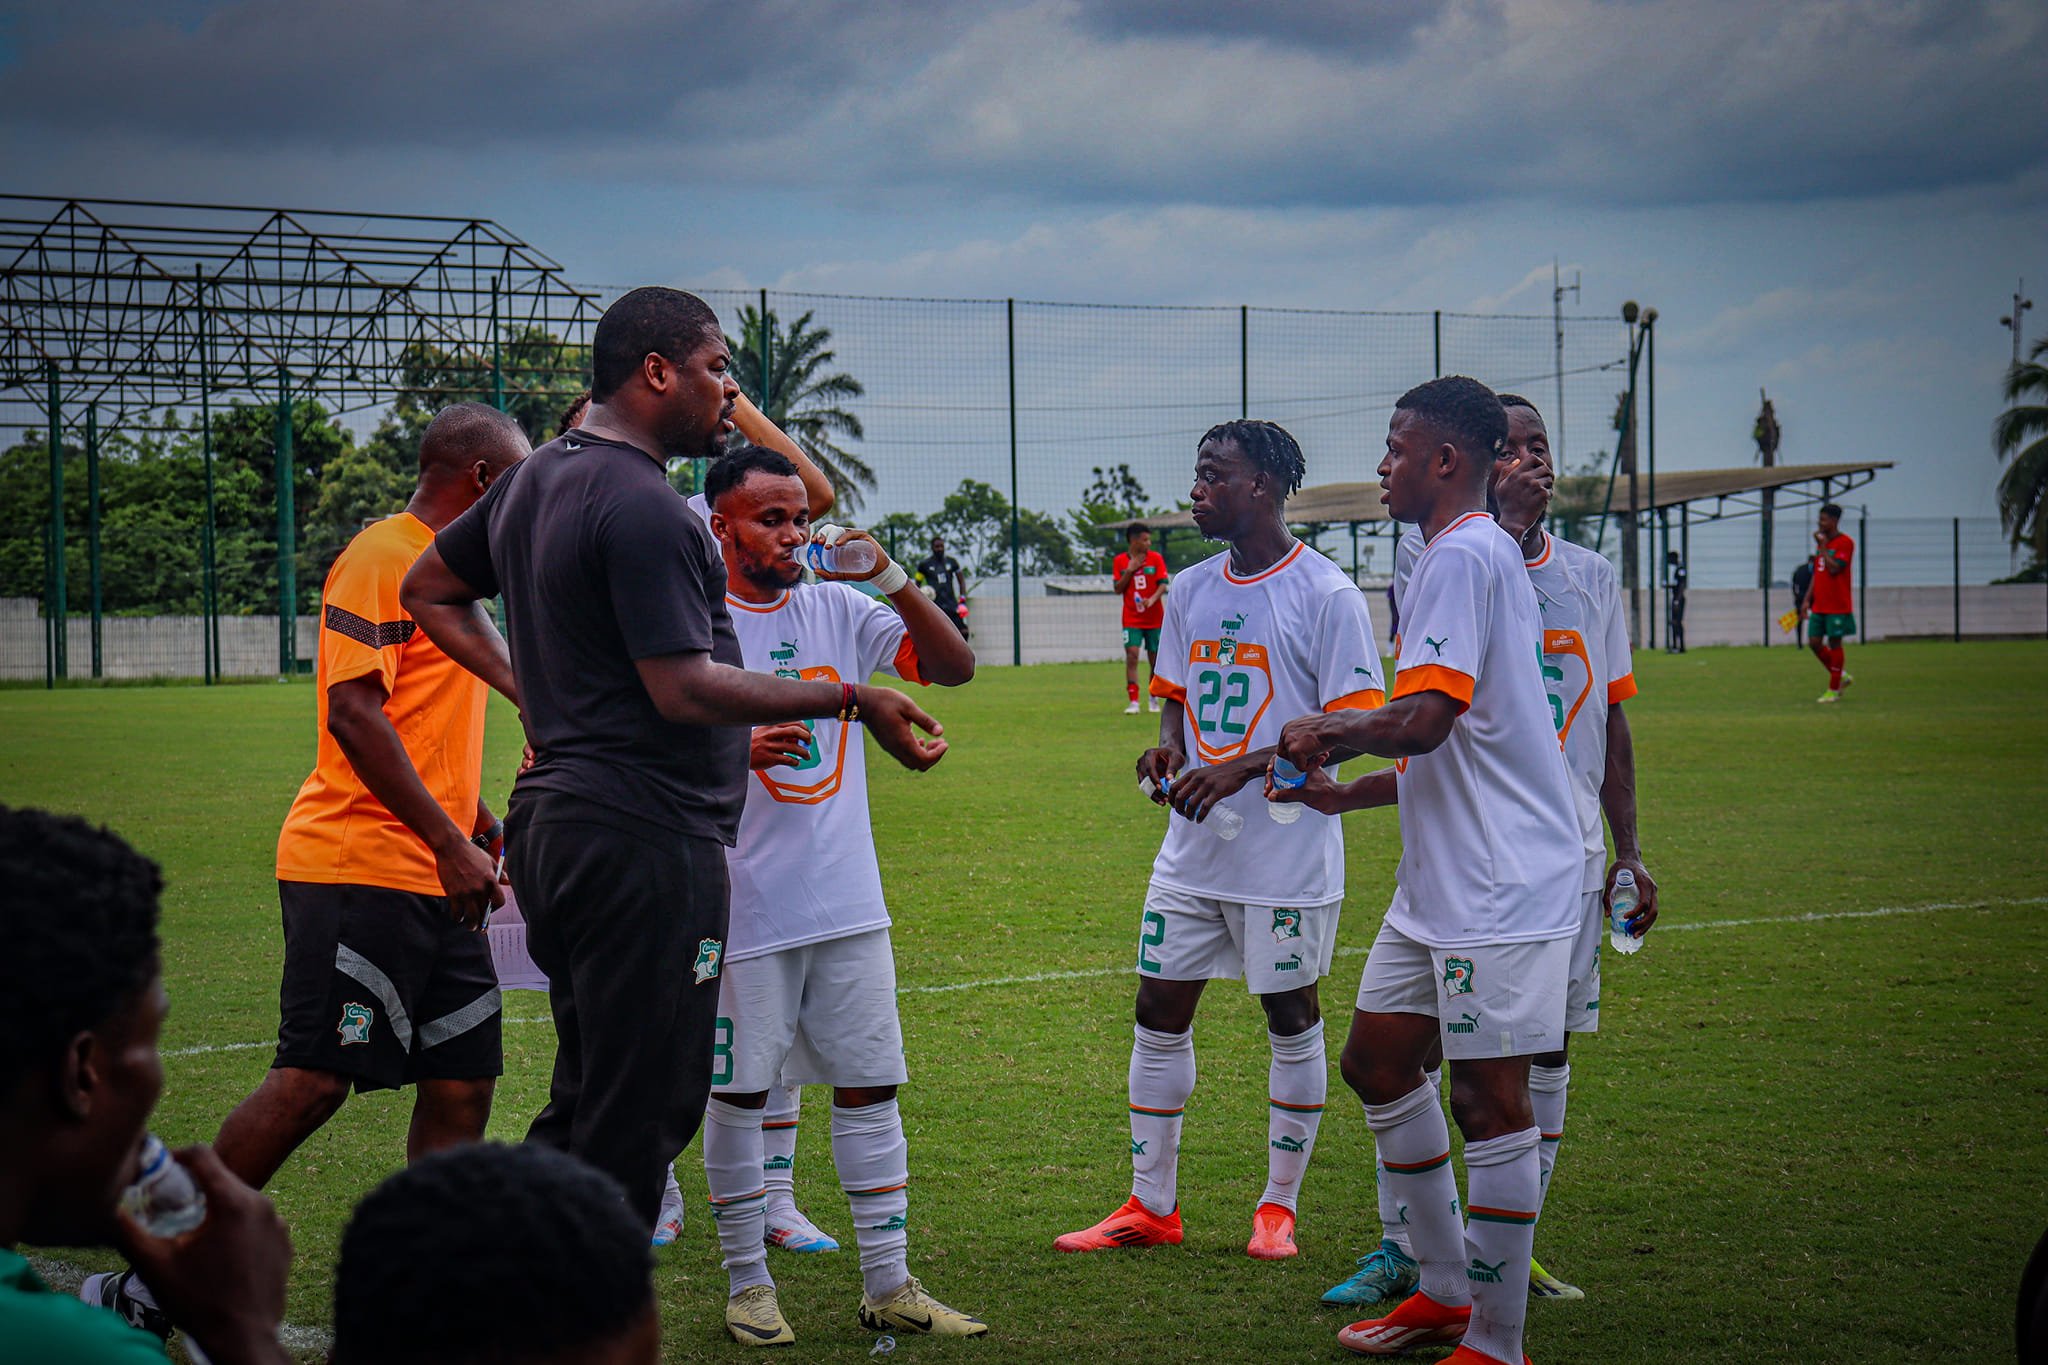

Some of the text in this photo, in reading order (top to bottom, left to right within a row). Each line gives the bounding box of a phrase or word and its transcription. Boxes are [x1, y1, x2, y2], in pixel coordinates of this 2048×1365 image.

[1221, 620, 1242, 630] PUMA
[770, 649, 795, 660] PUMA
[1199, 670, 1250, 734] 22
[1275, 961, 1299, 971] PUMA
[1447, 1022, 1474, 1033] PUMA
[1271, 1140, 1299, 1152] PUMA
[1466, 1267, 1495, 1283] UMA
